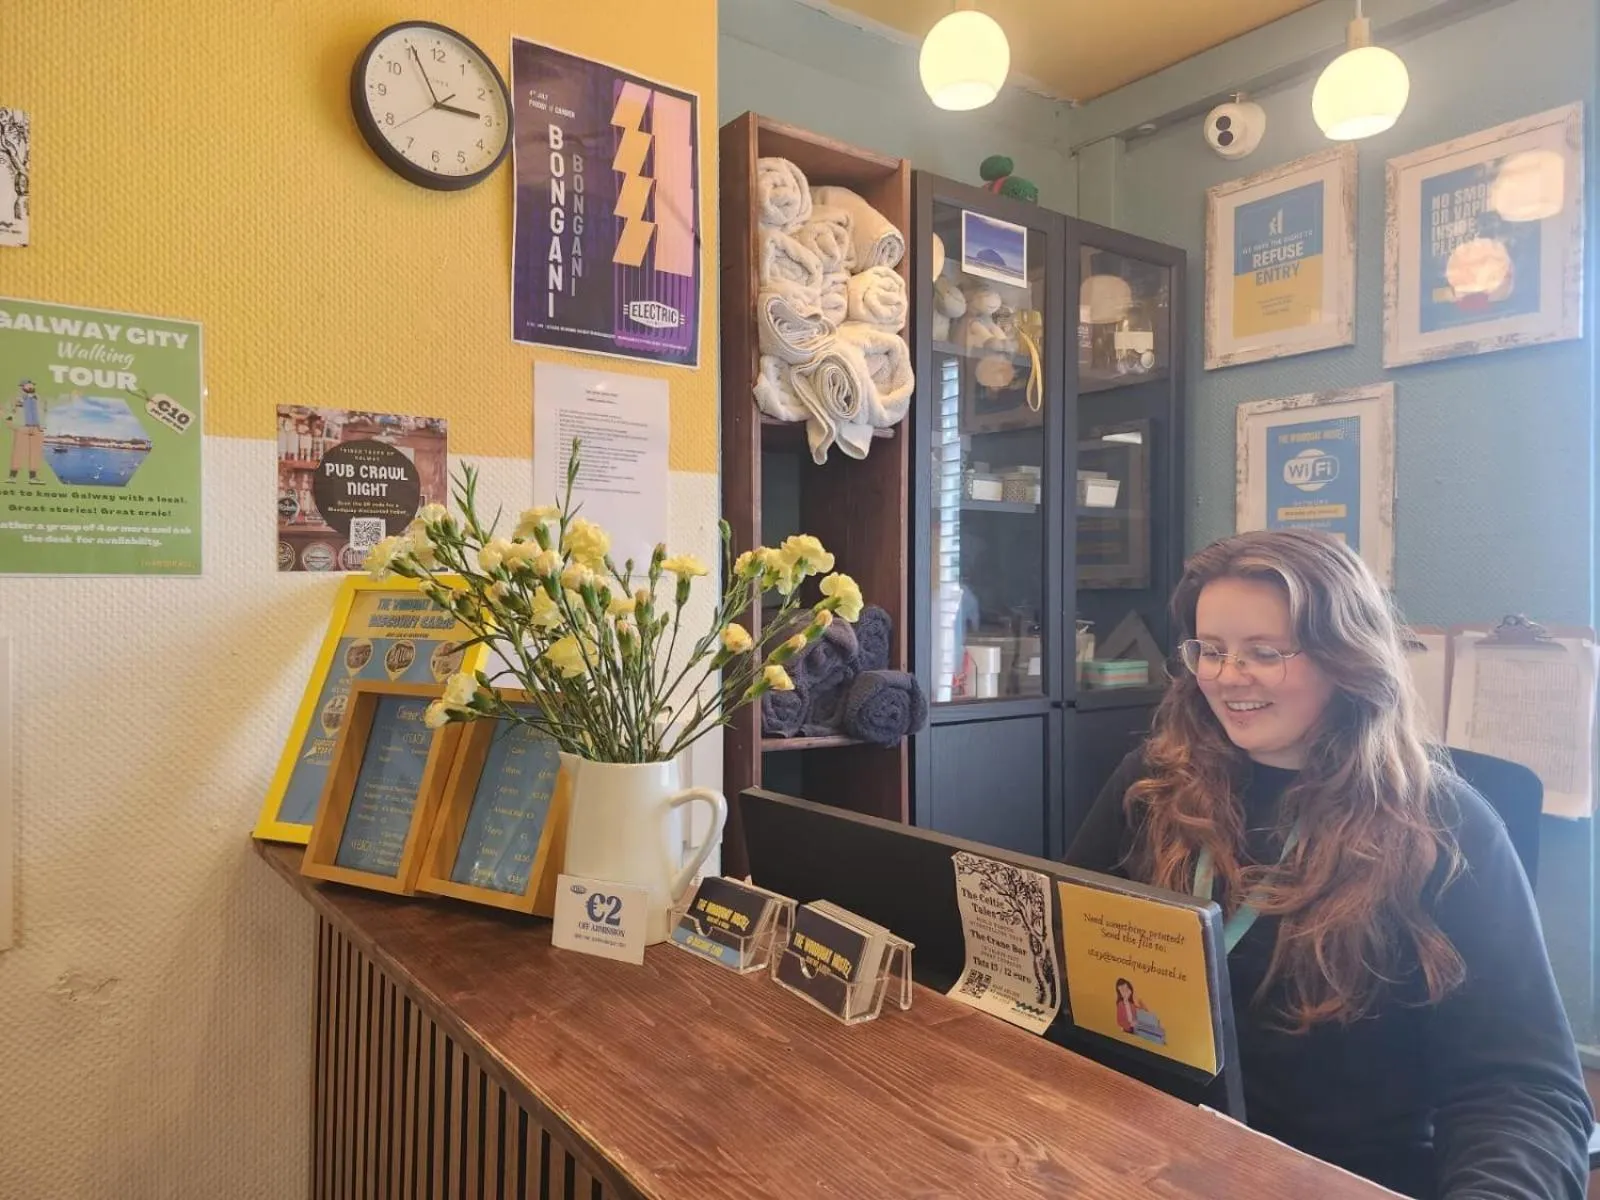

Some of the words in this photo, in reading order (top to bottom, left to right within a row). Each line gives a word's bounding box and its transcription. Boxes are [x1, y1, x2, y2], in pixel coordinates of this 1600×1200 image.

[406, 48, 418, 62] 11
[431, 48, 446, 63] 12
[386, 60, 402, 76] 10
[459, 64, 466, 76] 1
[377, 83, 387, 96] 9
[477, 88, 486, 101] 2
[385, 112, 395, 126] 8
[484, 114, 493, 127] 3
[406, 136, 415, 150] 7
[476, 138, 485, 151] 4
[431, 151, 440, 163] 6
[457, 151, 466, 164] 5
[1431, 193, 1450, 210] NO
[1454, 183, 1491, 205] SMO
[548, 124, 566, 318] BONGANI
[571, 154, 585, 297] BONGANI
[1252, 241, 1304, 269] REFUSE
[1256, 263, 1300, 286] ENTRY
[631, 303, 678, 324] ELECTRIC
[0, 310, 122, 341] GALWAY
[126, 327, 189, 349] CITY
[57, 341, 136, 369] Walking
[48, 365, 139, 390] TOUR
[325, 463, 356, 478] PUB
[360, 465, 409, 481] CRAWL
[1288, 461, 1332, 479] WiFi
[36, 490, 68, 498] know
[71, 491, 116, 502] Galway
[118, 494, 145, 502] with
[347, 482, 389, 497] NIGHT
[8, 504, 46, 512] Great
[49, 505, 97, 514] stories!
[101, 507, 135, 516] Great
[0, 521, 35, 530] ather
[961, 887, 978, 899] The
[585, 892, 622, 927] €2
[970, 928, 985, 940] The
[1083, 912, 1104, 925] Need
[1105, 921, 1147, 939] something
[1149, 930, 1185, 944] printed?
[1101, 927, 1120, 940] Send
[1122, 932, 1136, 945] the
[1136, 937, 1153, 949] file
